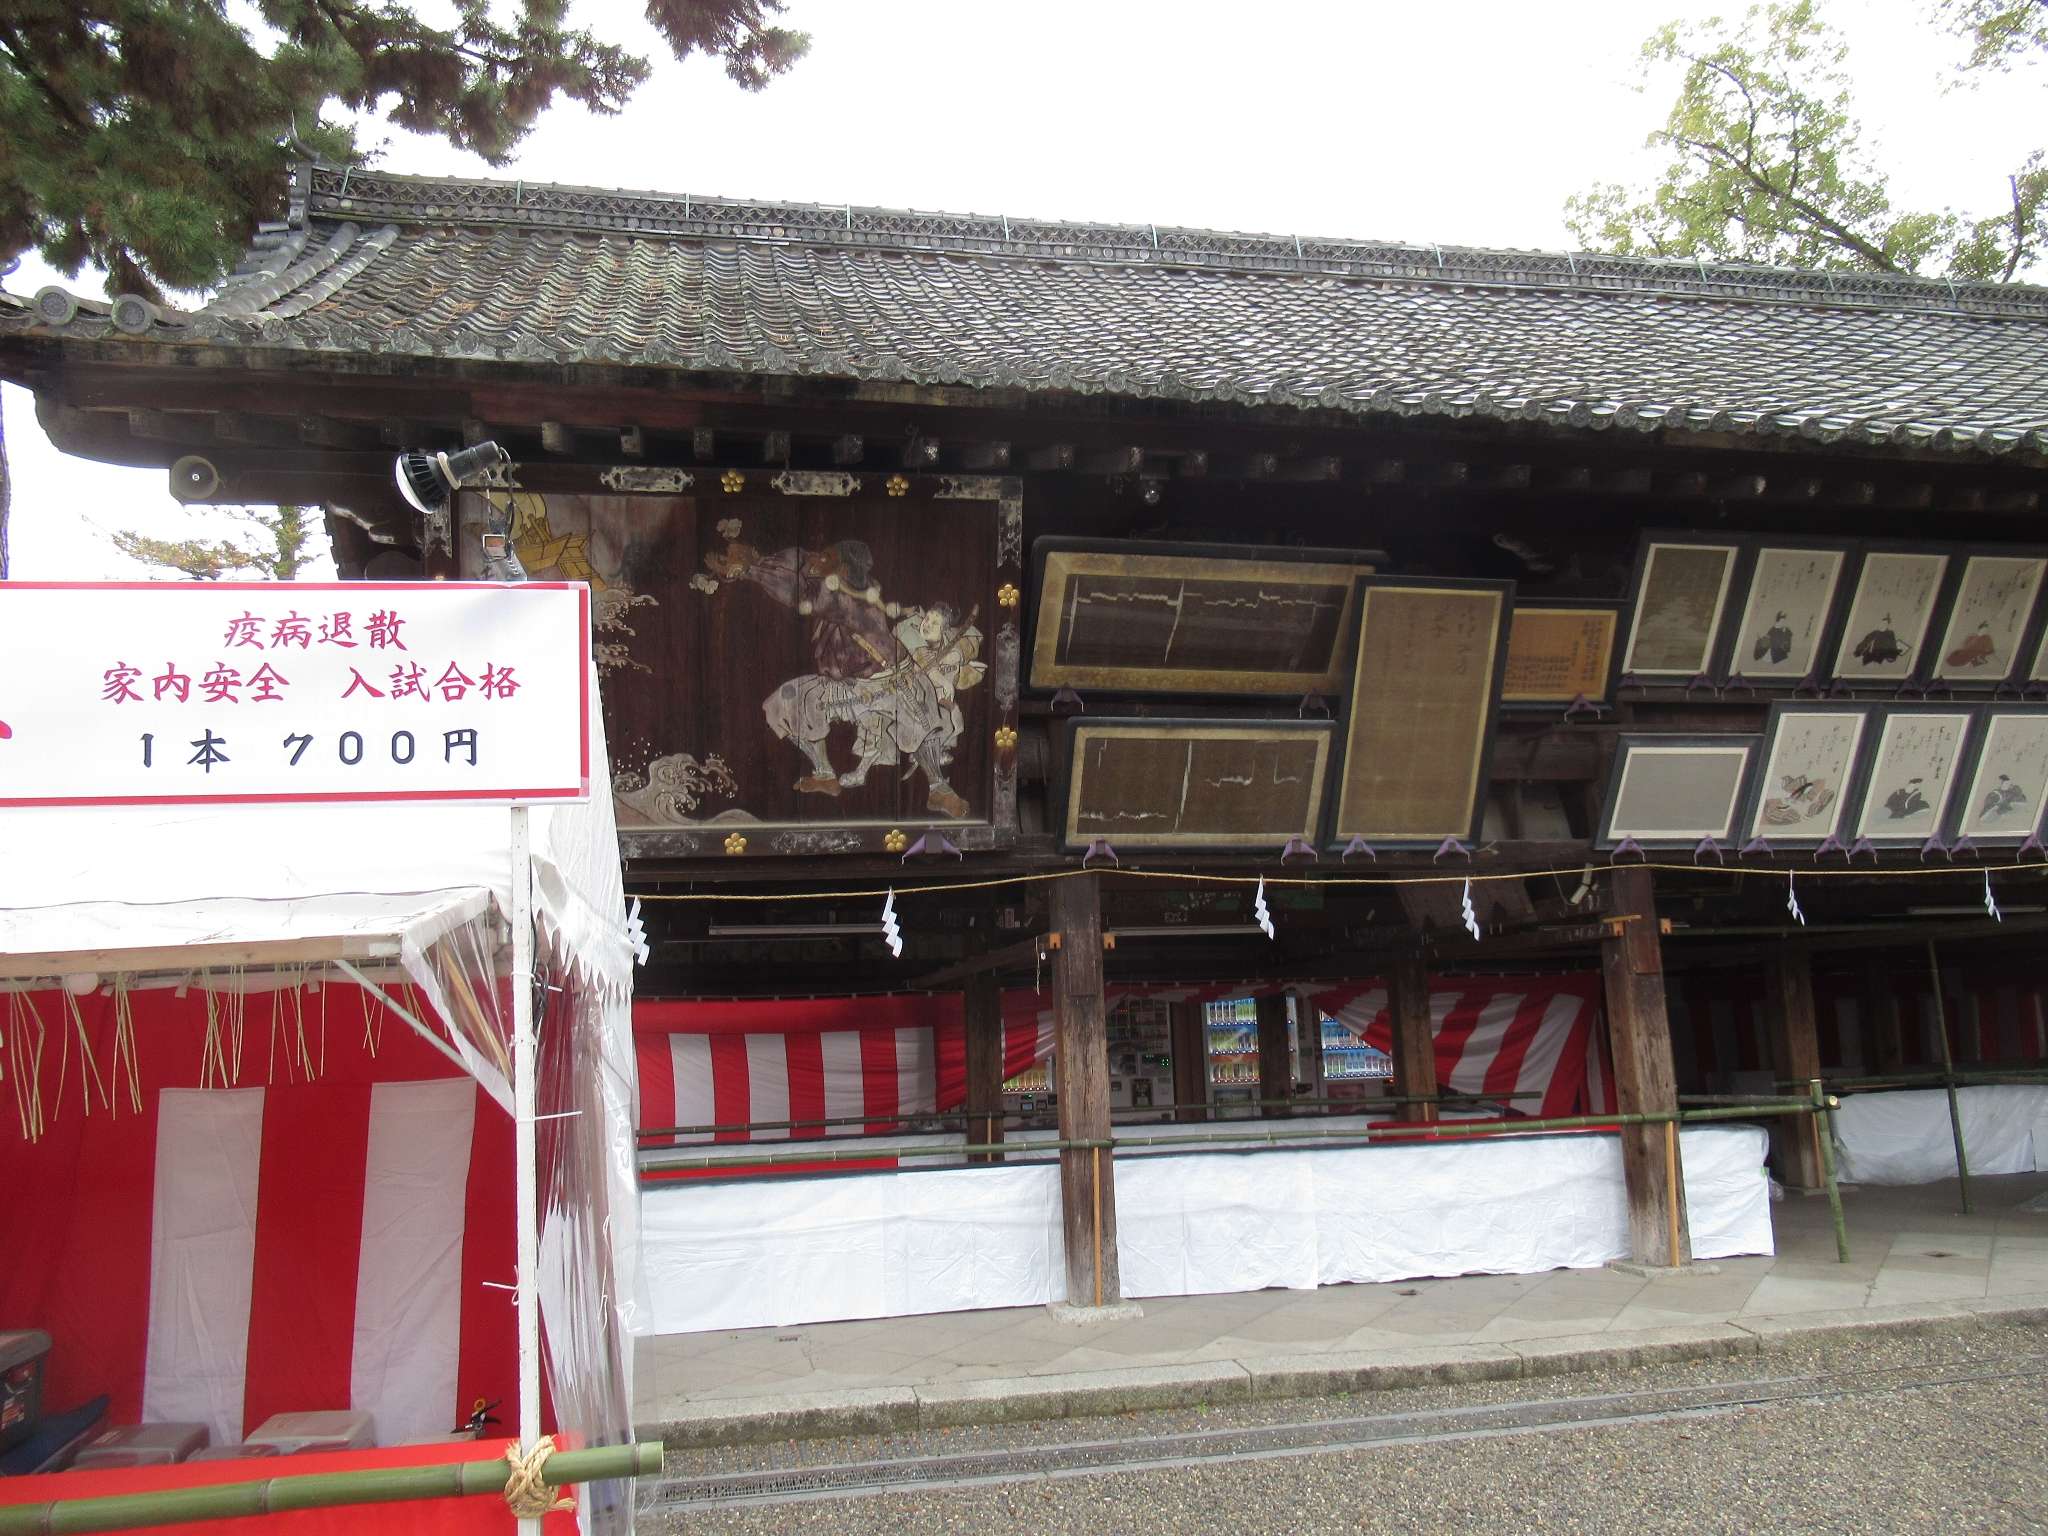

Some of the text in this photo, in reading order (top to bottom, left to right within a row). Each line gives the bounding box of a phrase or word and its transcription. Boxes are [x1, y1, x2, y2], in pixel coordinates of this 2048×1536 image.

[224, 609, 408, 651] 疫病退散
[102, 660, 521, 705] 家内安全 入試合格
